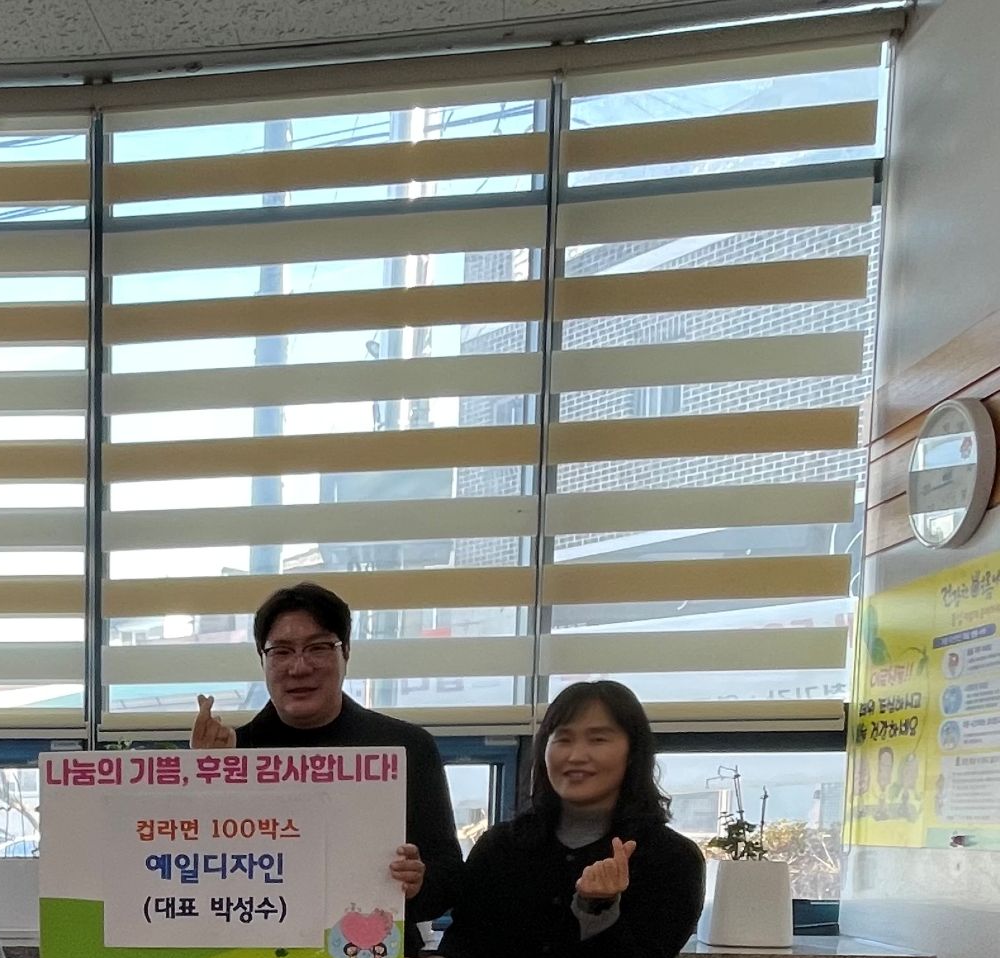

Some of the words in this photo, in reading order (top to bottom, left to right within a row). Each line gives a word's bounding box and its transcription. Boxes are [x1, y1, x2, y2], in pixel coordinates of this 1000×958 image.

[46, 758, 122, 786] 나눔의
[130, 757, 189, 786] 기쁨,
[196, 755, 248, 784] 후원
[256, 753, 398, 782] 감사합니다!
[136, 820, 199, 841] 컵라면
[212, 819, 300, 840] 100박스
[146, 853, 284, 884] 예일디자인
[144, 896, 199, 922] (대표
[210, 896, 287, 923] 박성수)
